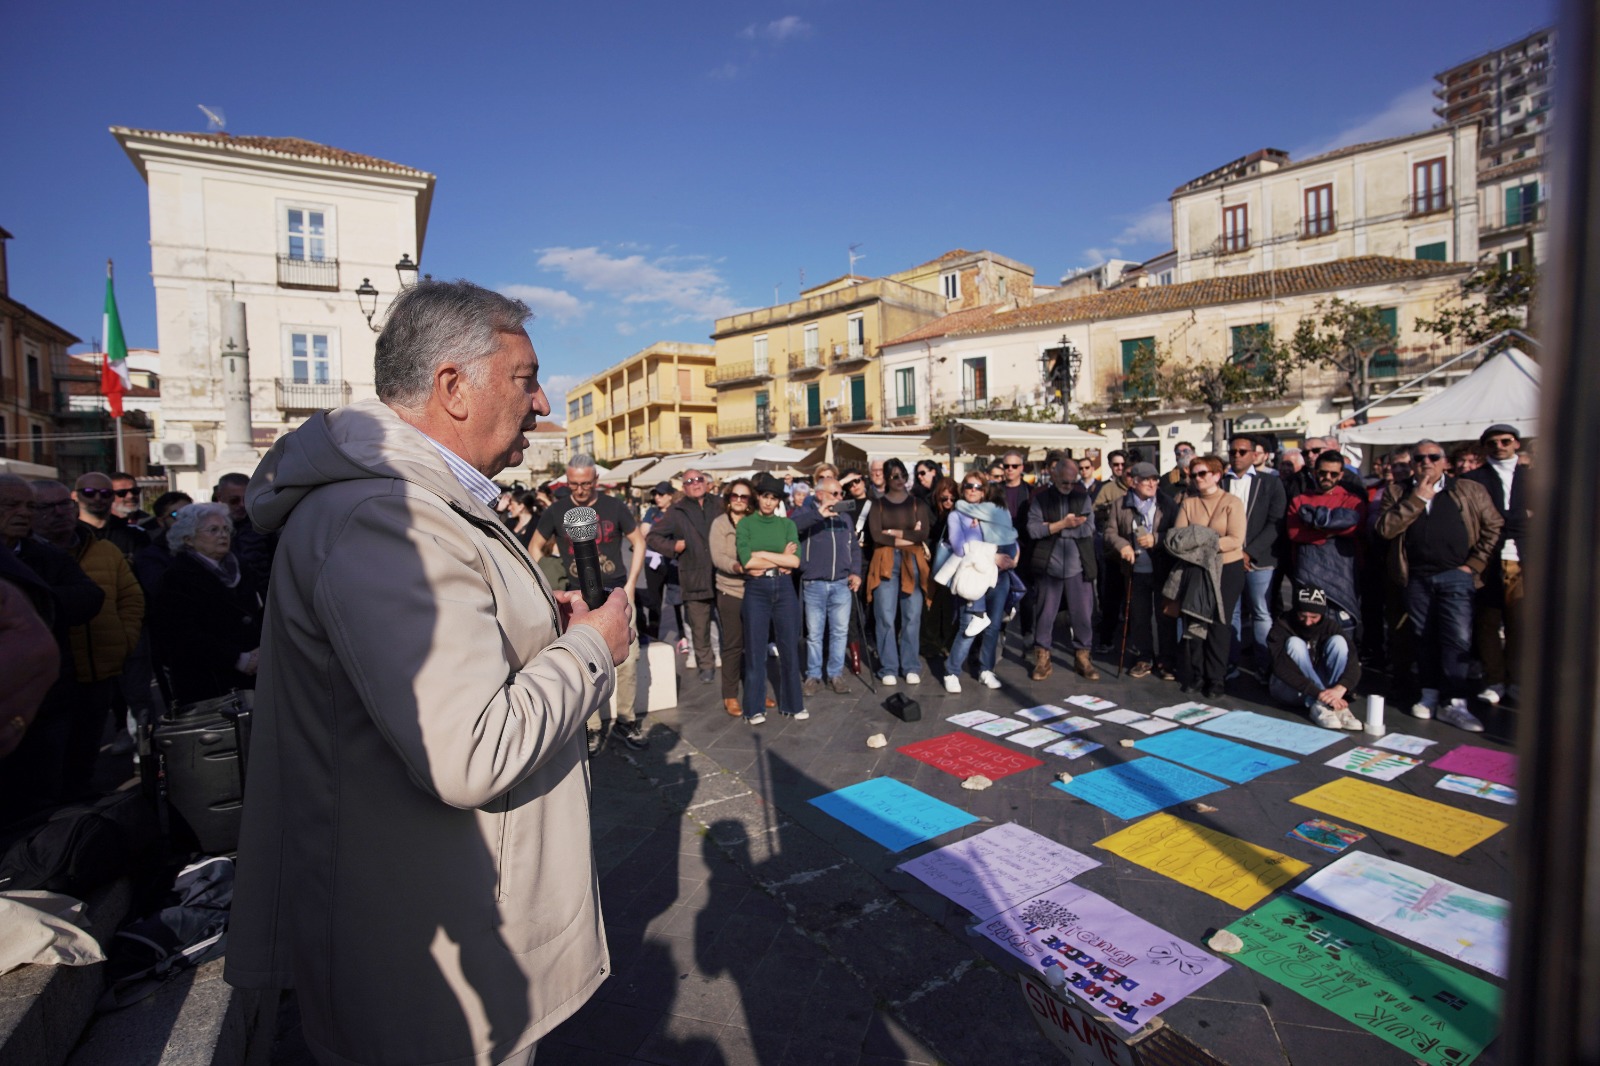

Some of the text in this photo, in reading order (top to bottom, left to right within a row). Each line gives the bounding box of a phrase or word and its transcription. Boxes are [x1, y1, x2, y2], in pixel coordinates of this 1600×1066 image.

[1121, 840, 1161, 858] LA
[1156, 853, 1248, 897] HASTA
[1026, 982, 1120, 1066] SHAME
